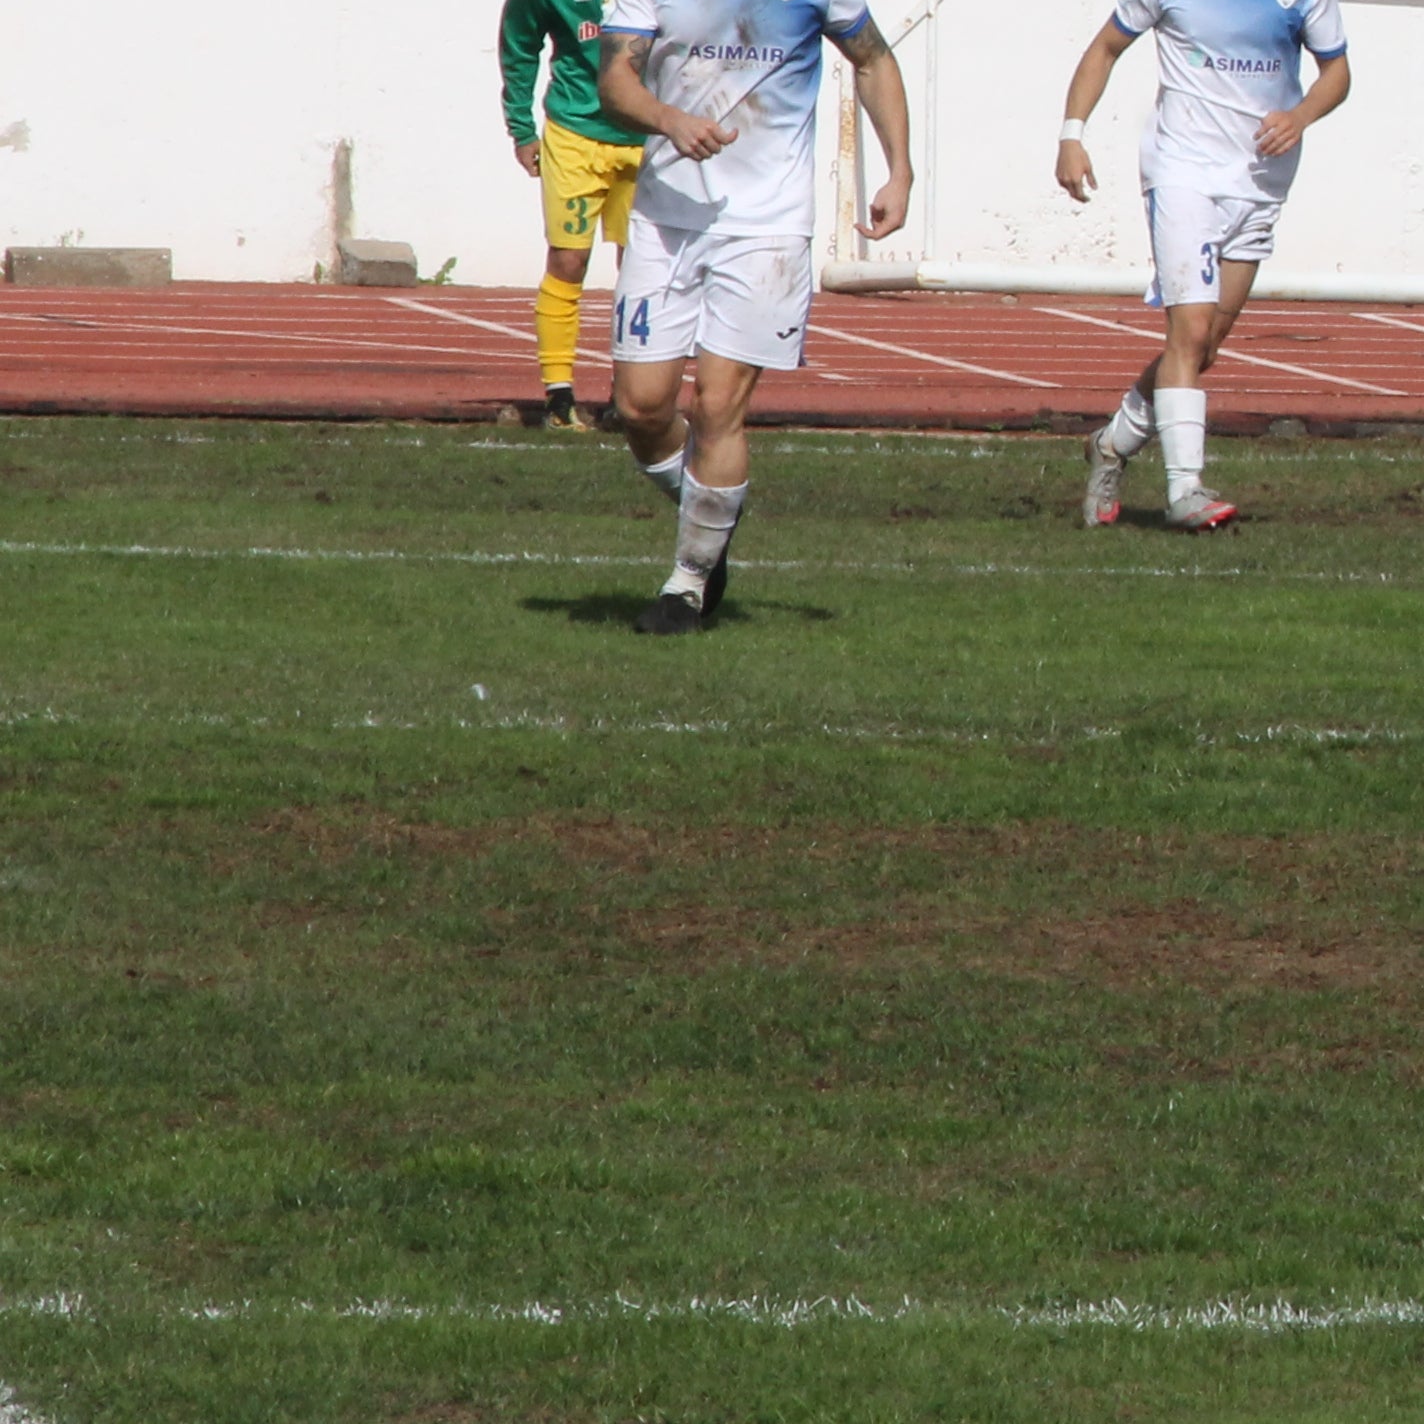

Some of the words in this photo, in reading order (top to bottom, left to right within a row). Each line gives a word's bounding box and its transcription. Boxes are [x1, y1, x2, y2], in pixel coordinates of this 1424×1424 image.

[689, 45, 784, 62] ASIMAIR
[1203, 56, 1281, 73] ASIMAIR
[563, 196, 588, 235] 3
[1200, 242, 1214, 286] 3
[616, 294, 650, 346] 14
